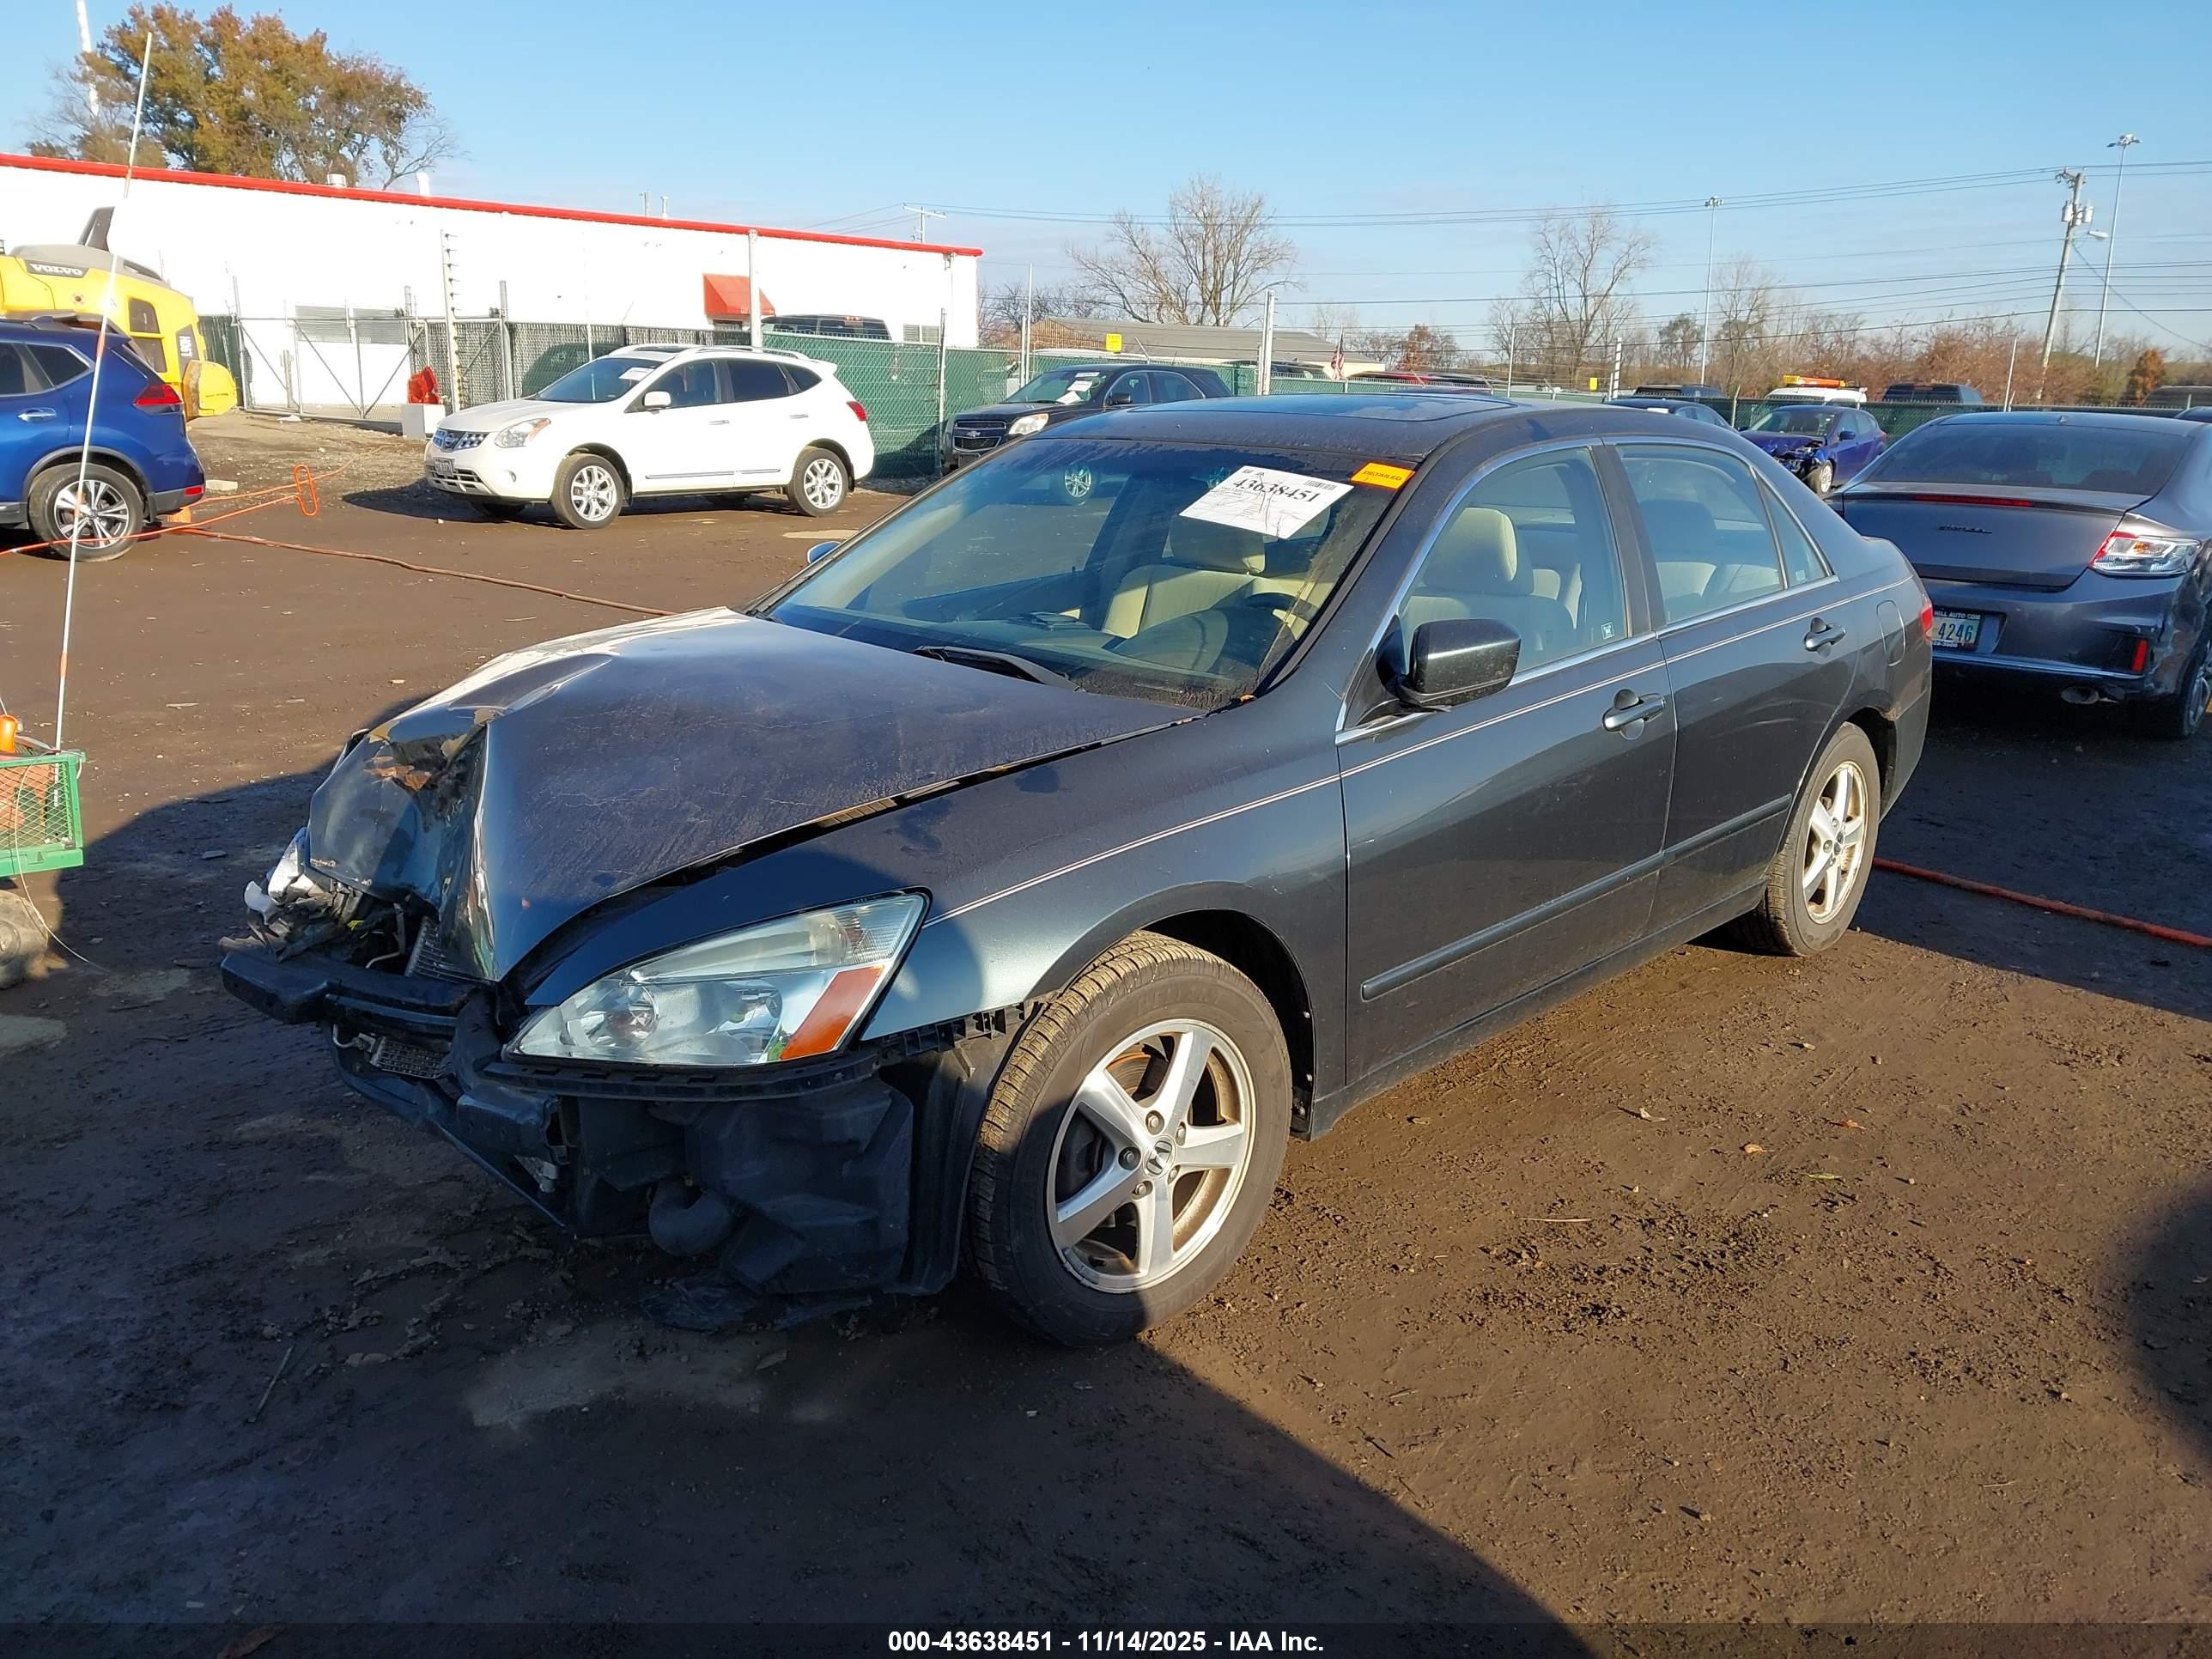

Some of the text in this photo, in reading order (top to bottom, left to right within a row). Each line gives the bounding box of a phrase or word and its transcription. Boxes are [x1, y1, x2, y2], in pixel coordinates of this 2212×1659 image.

[29, 263, 83, 276] VOLVO
[1362, 470, 1402, 481] DETAILED
[1232, 478, 1321, 502] 43638451
[1938, 622, 1974, 642] 4246
